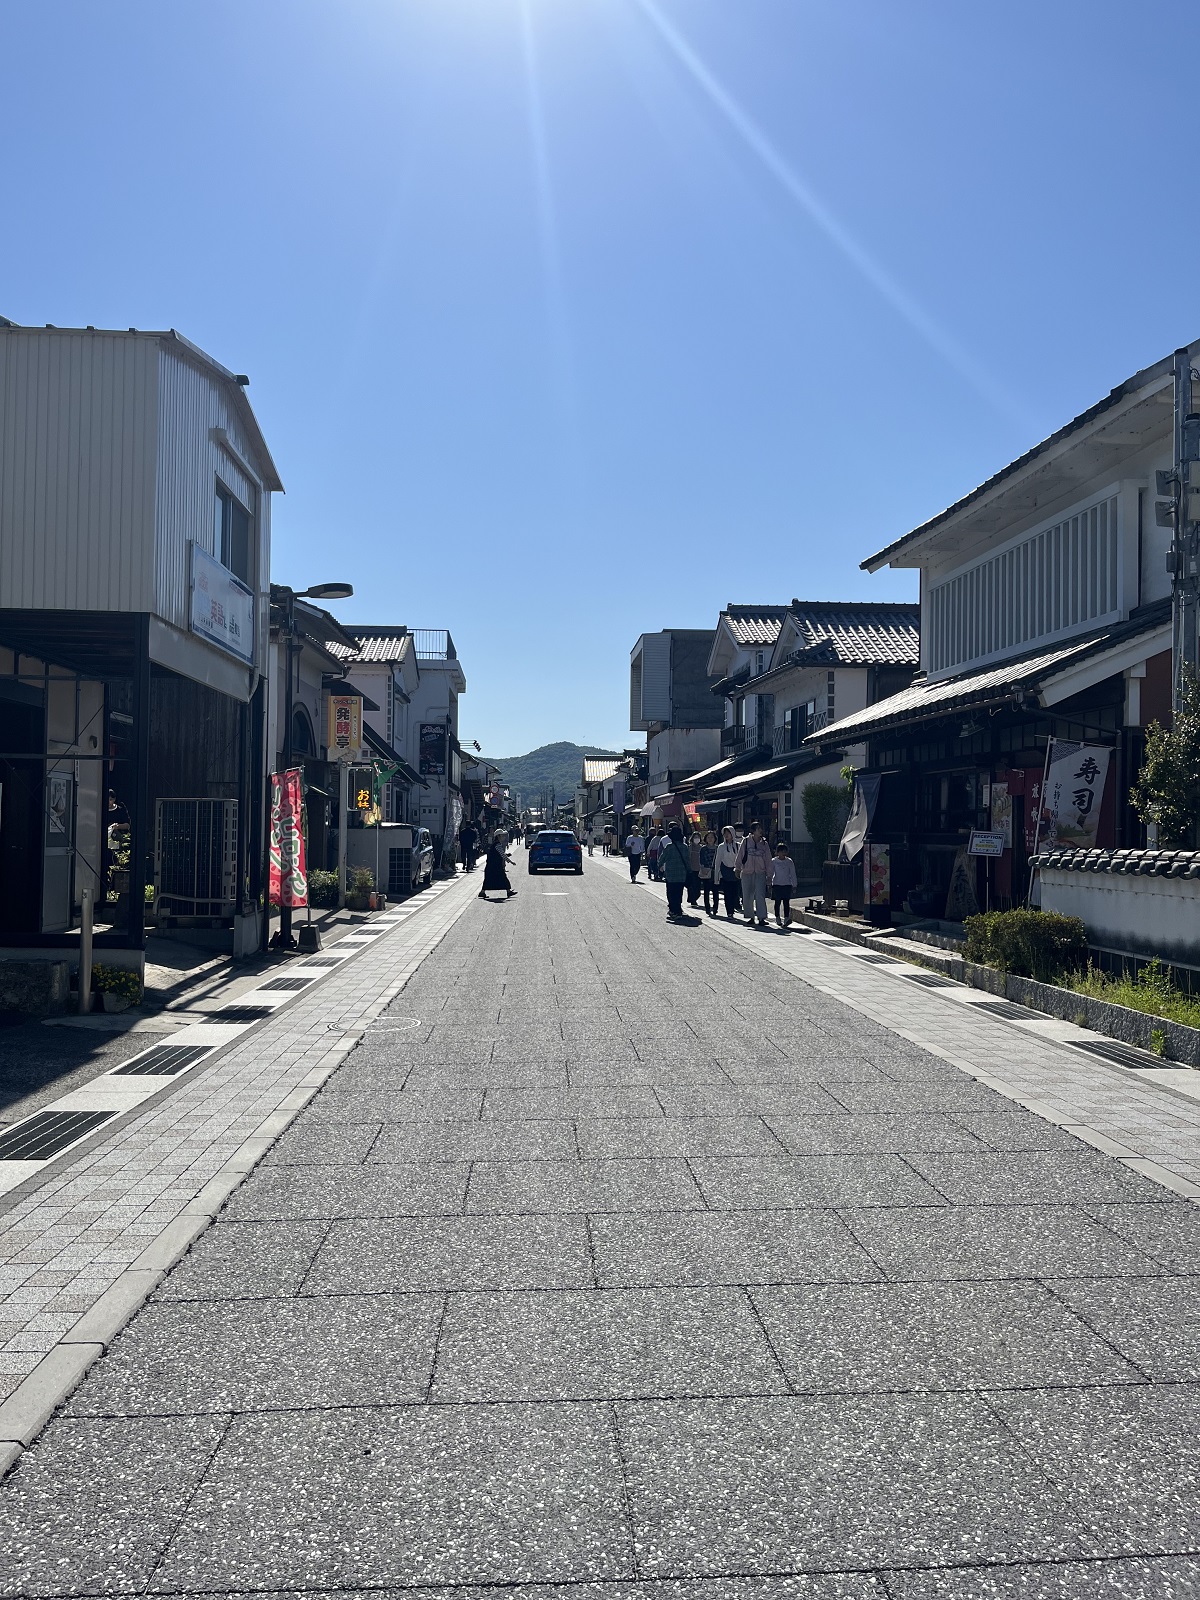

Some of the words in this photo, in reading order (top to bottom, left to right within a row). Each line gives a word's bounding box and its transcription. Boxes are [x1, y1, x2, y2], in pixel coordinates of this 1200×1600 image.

[336, 707, 350, 749] 発酵亭
[1072, 757, 1101, 815] 寿司
